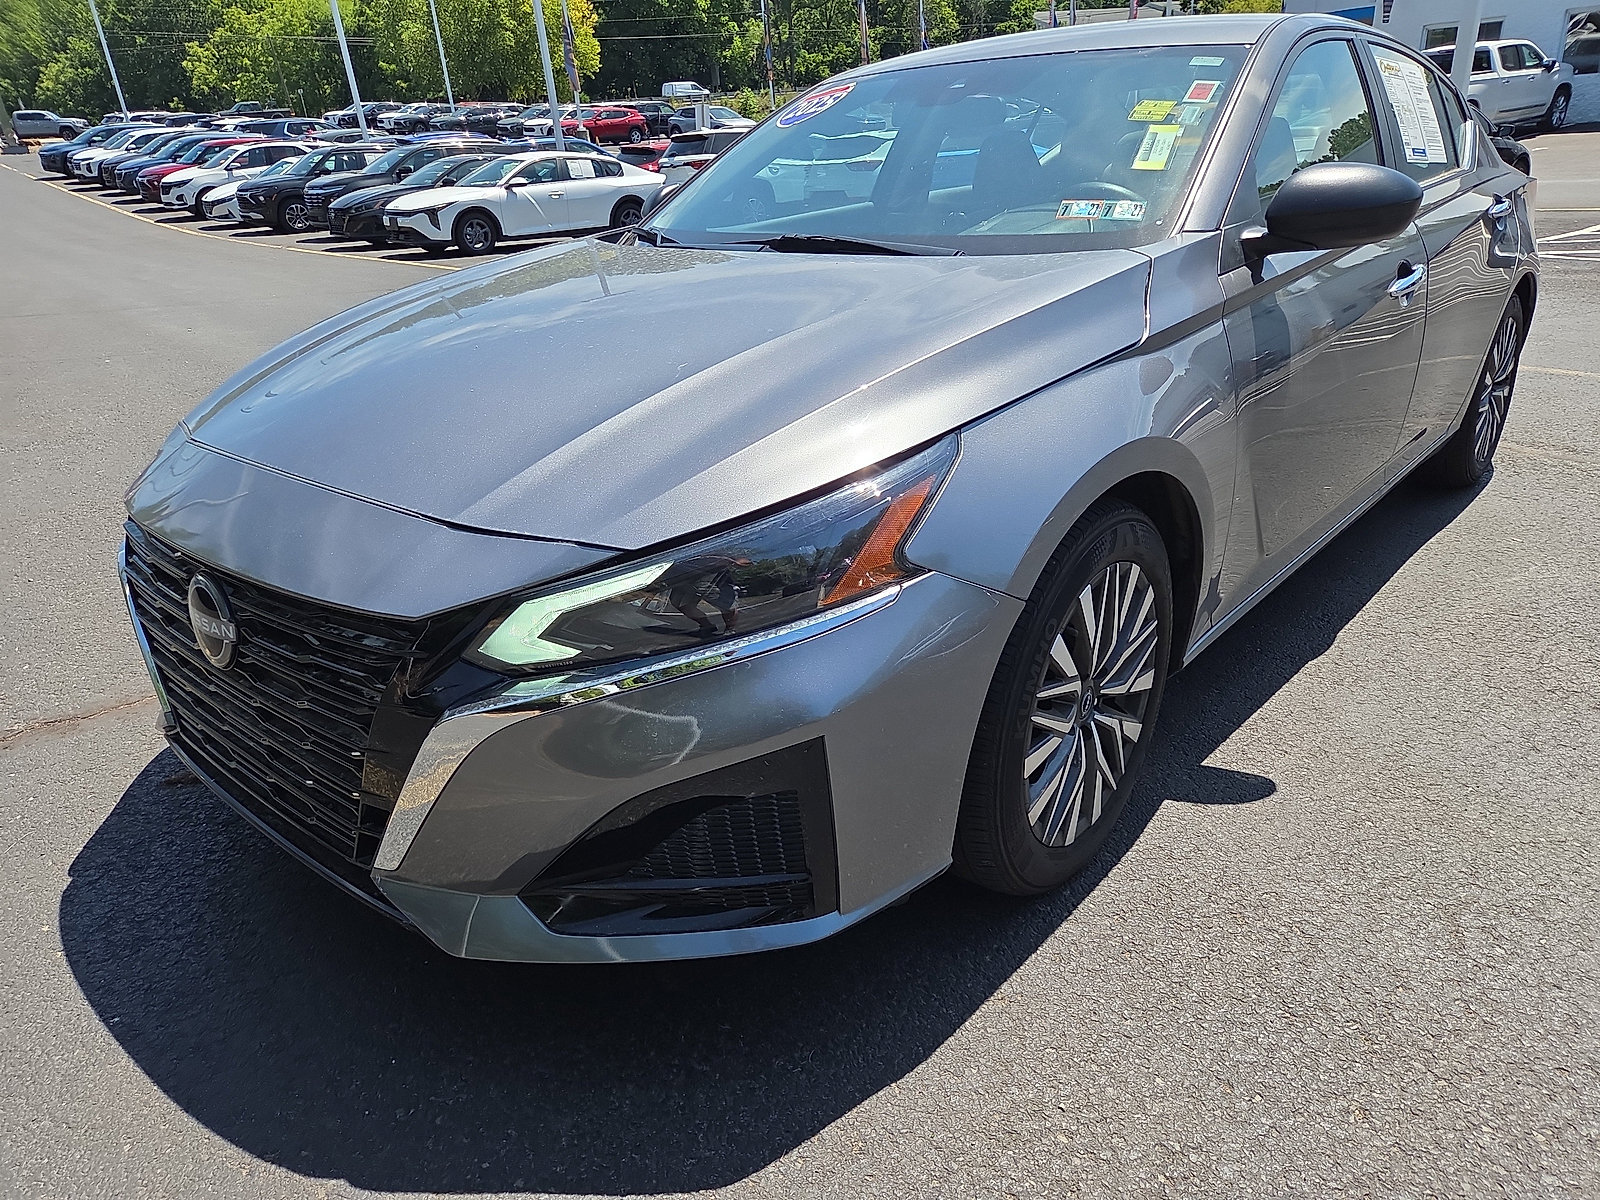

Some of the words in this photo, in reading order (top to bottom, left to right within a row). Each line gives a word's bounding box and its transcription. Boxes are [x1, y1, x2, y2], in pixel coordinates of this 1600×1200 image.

[781, 94, 843, 120] 2025
[1061, 205, 1068, 216] 7
[1087, 203, 1100, 216] 27
[1104, 205, 1112, 217] 7
[1131, 203, 1143, 217] 27
[193, 612, 234, 639] SSAN
